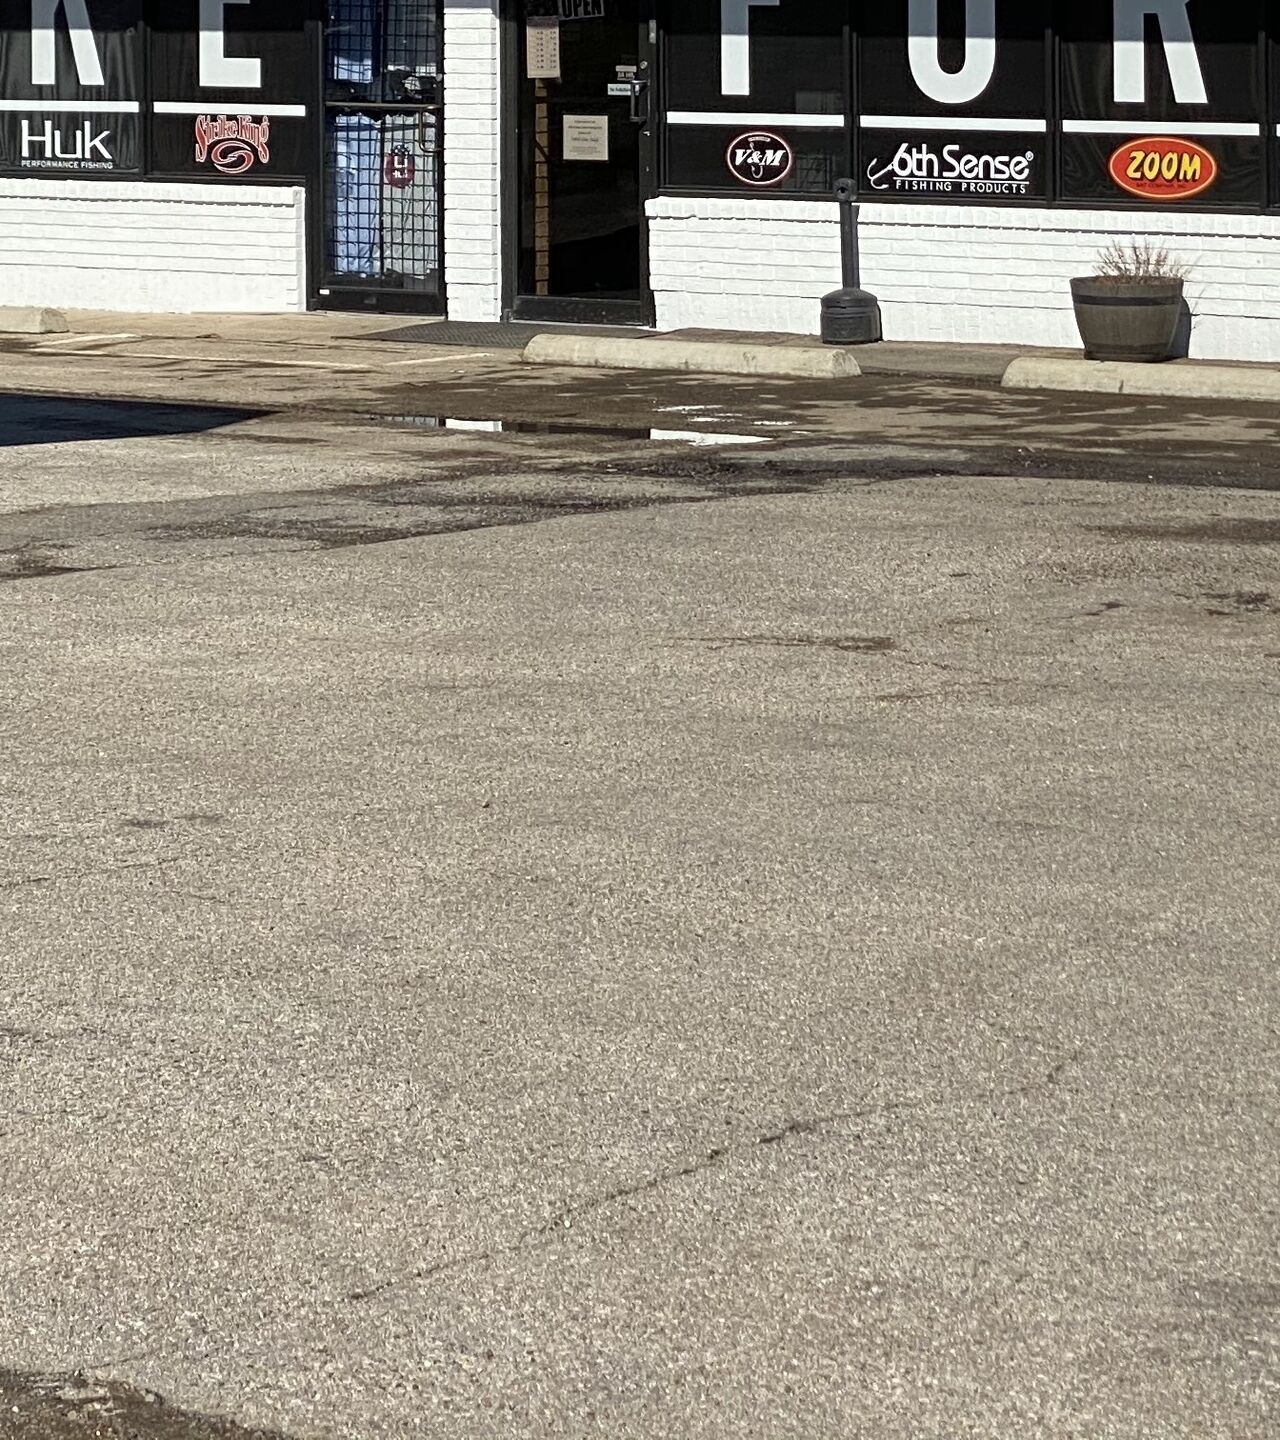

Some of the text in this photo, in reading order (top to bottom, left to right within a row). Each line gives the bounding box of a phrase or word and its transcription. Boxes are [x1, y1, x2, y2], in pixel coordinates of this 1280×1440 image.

[195, 115, 270, 164] Strike King
[21, 160, 114, 169] PERFORMANCE FISHING
[733, 148, 786, 167] V&M
[892, 142, 937, 178] 6th
[1125, 150, 1202, 181] ZOOM
[896, 180, 1027, 194] FISHING PRODUCTS
